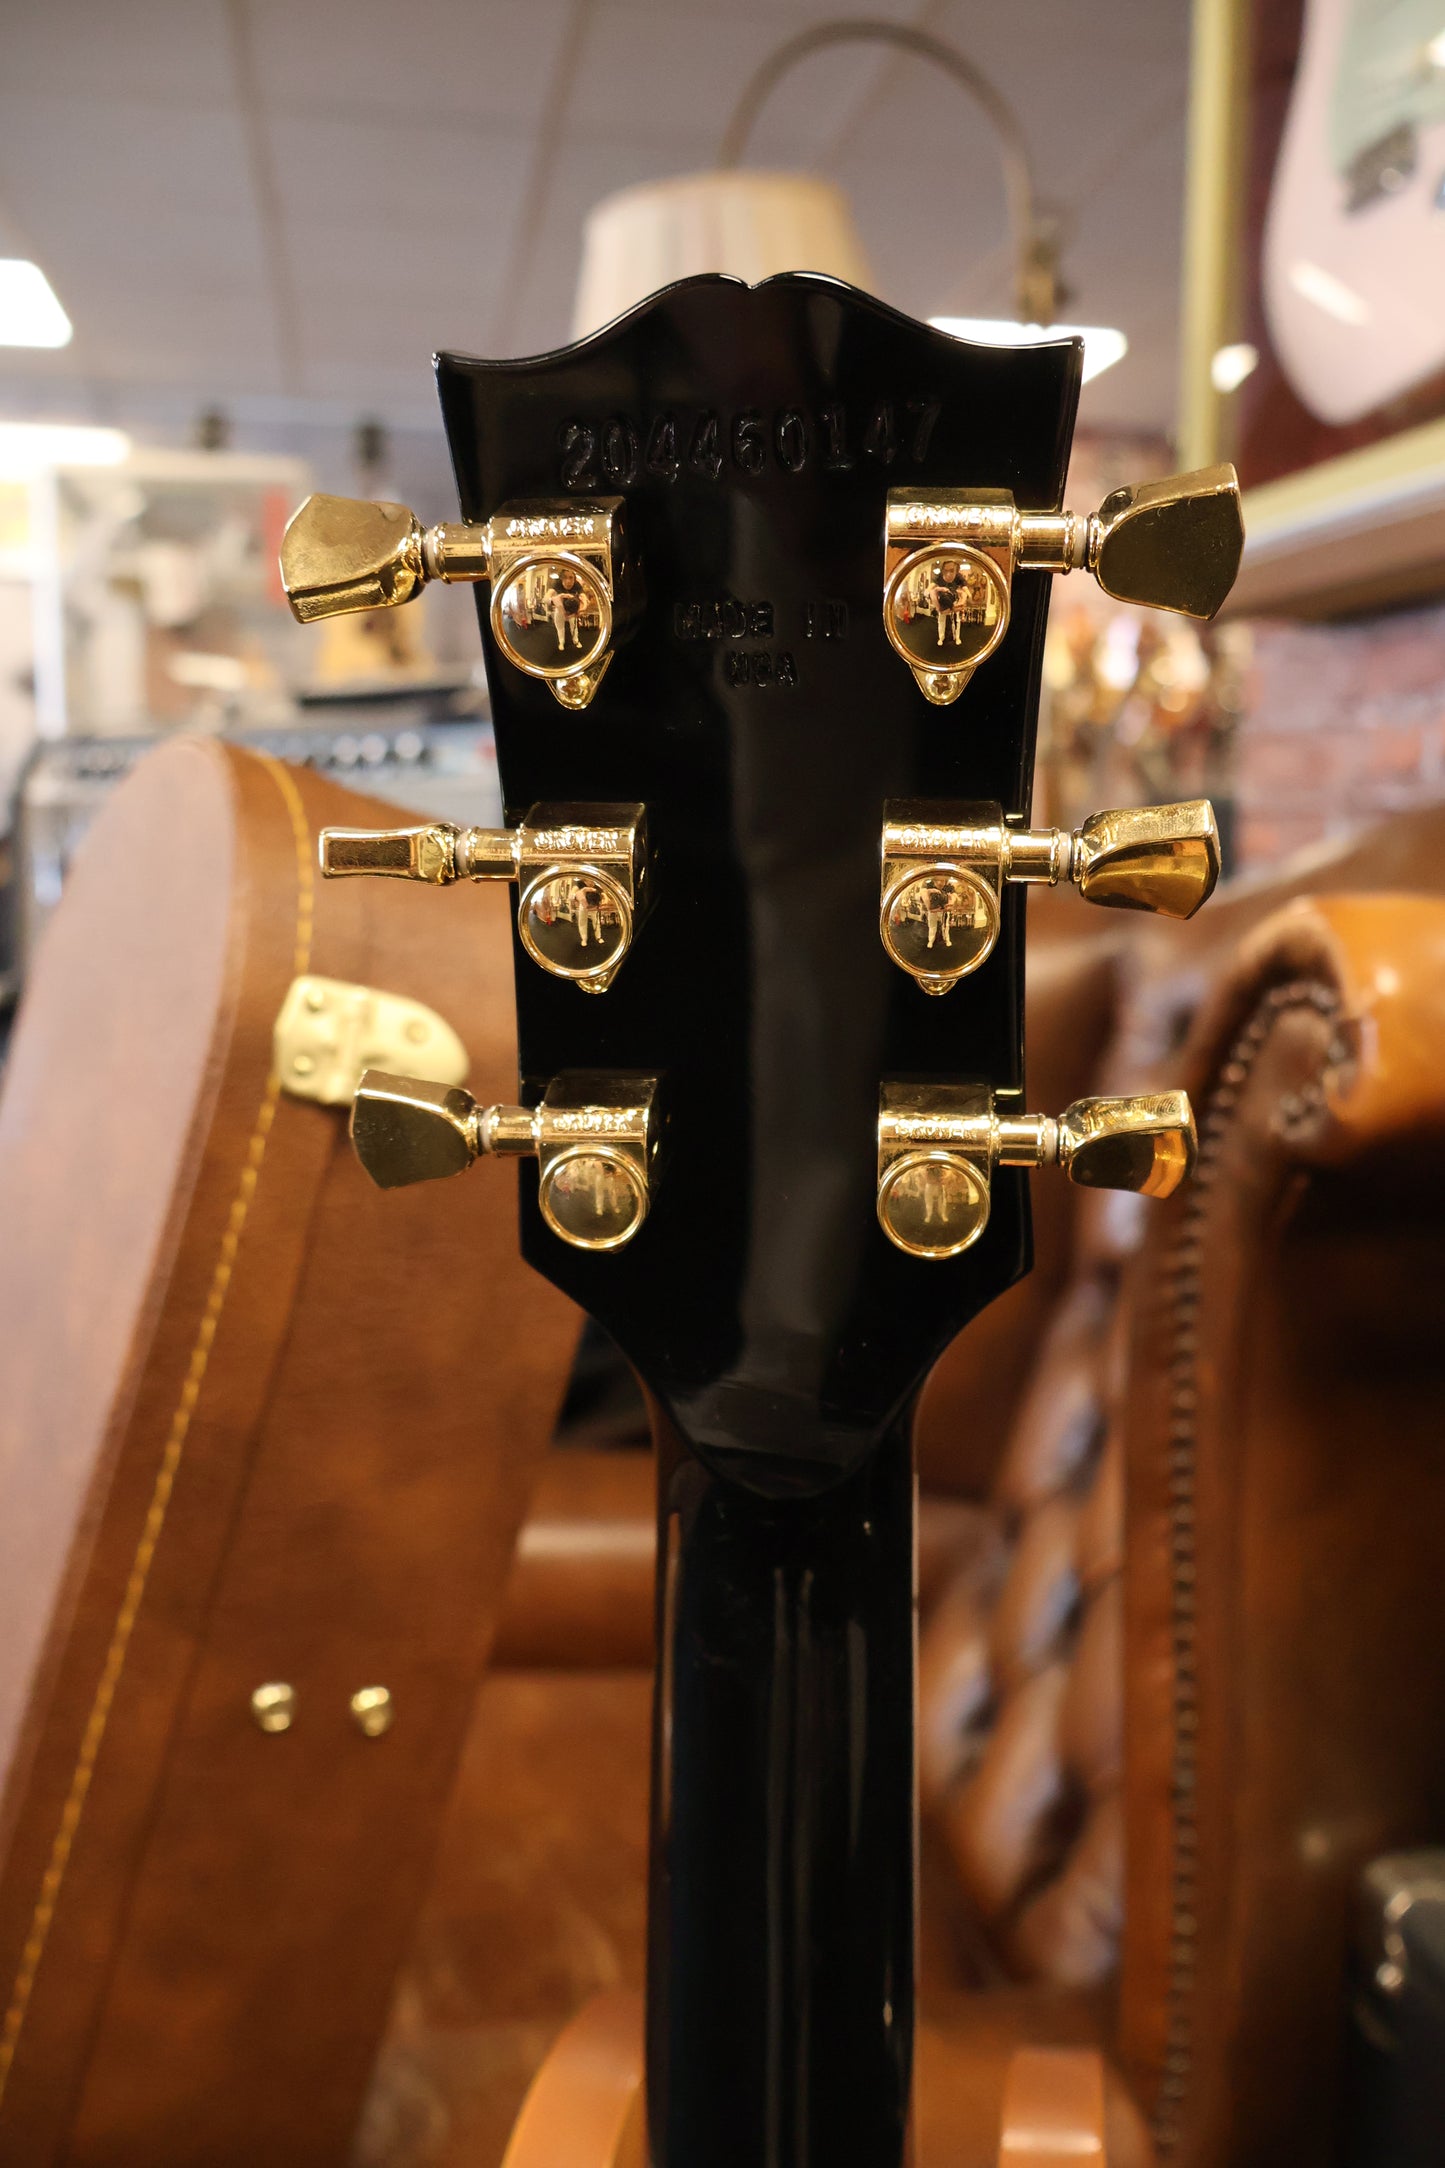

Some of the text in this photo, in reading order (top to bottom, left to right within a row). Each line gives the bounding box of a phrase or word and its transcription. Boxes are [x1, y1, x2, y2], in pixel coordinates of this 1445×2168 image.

[561, 399, 941, 489] 204460147
[673, 600, 848, 640] MADE IN
[725, 650, 799, 688] USA
